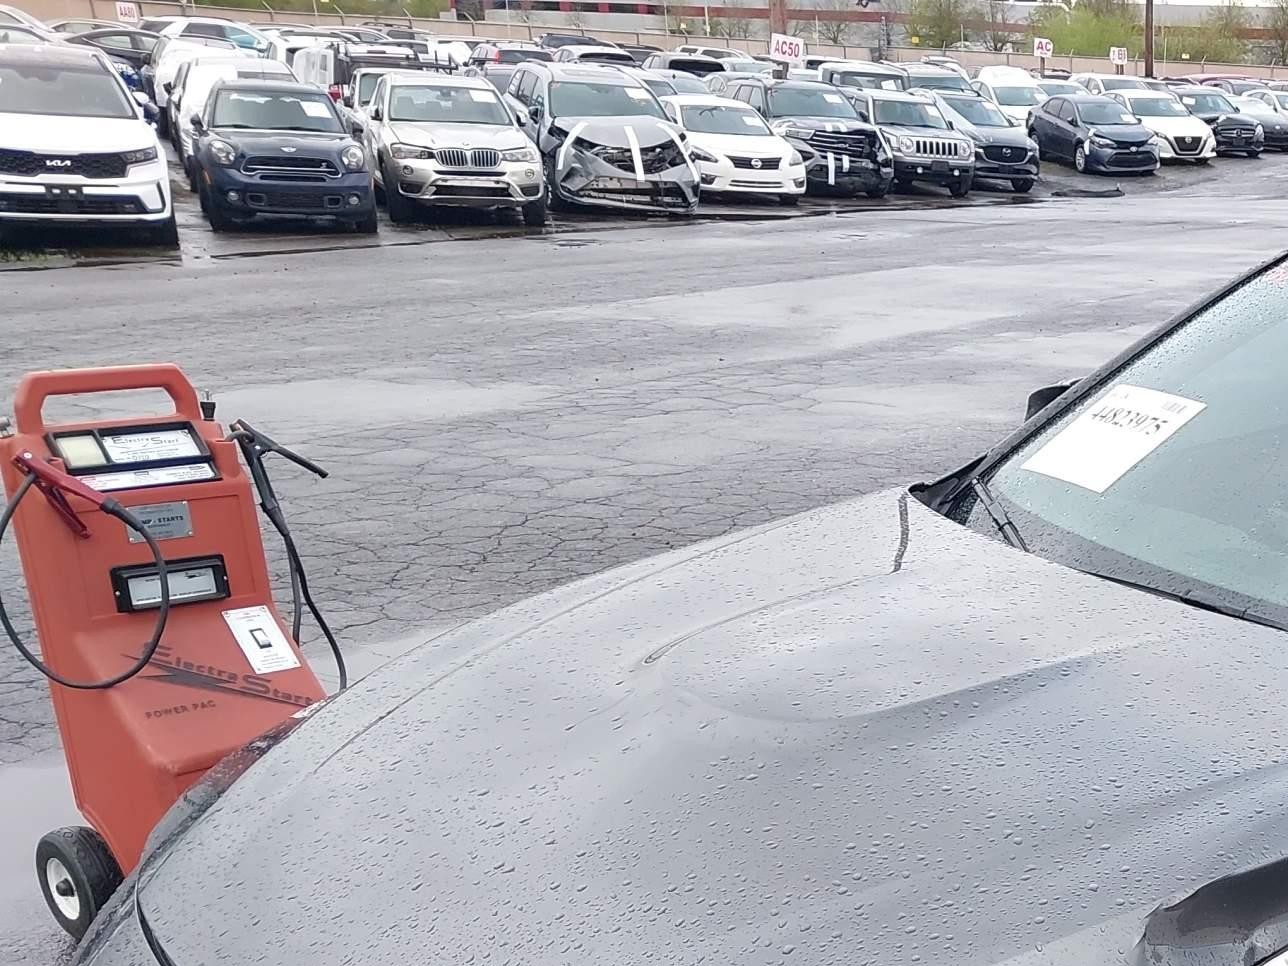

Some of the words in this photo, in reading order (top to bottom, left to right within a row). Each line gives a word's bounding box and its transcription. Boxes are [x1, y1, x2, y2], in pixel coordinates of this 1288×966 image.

[774, 40, 800, 58] AC50
[143, 640, 238, 682] Electra
[240, 674, 314, 705] Start
[145, 704, 190, 719] POWER
[192, 700, 217, 711] PAC
